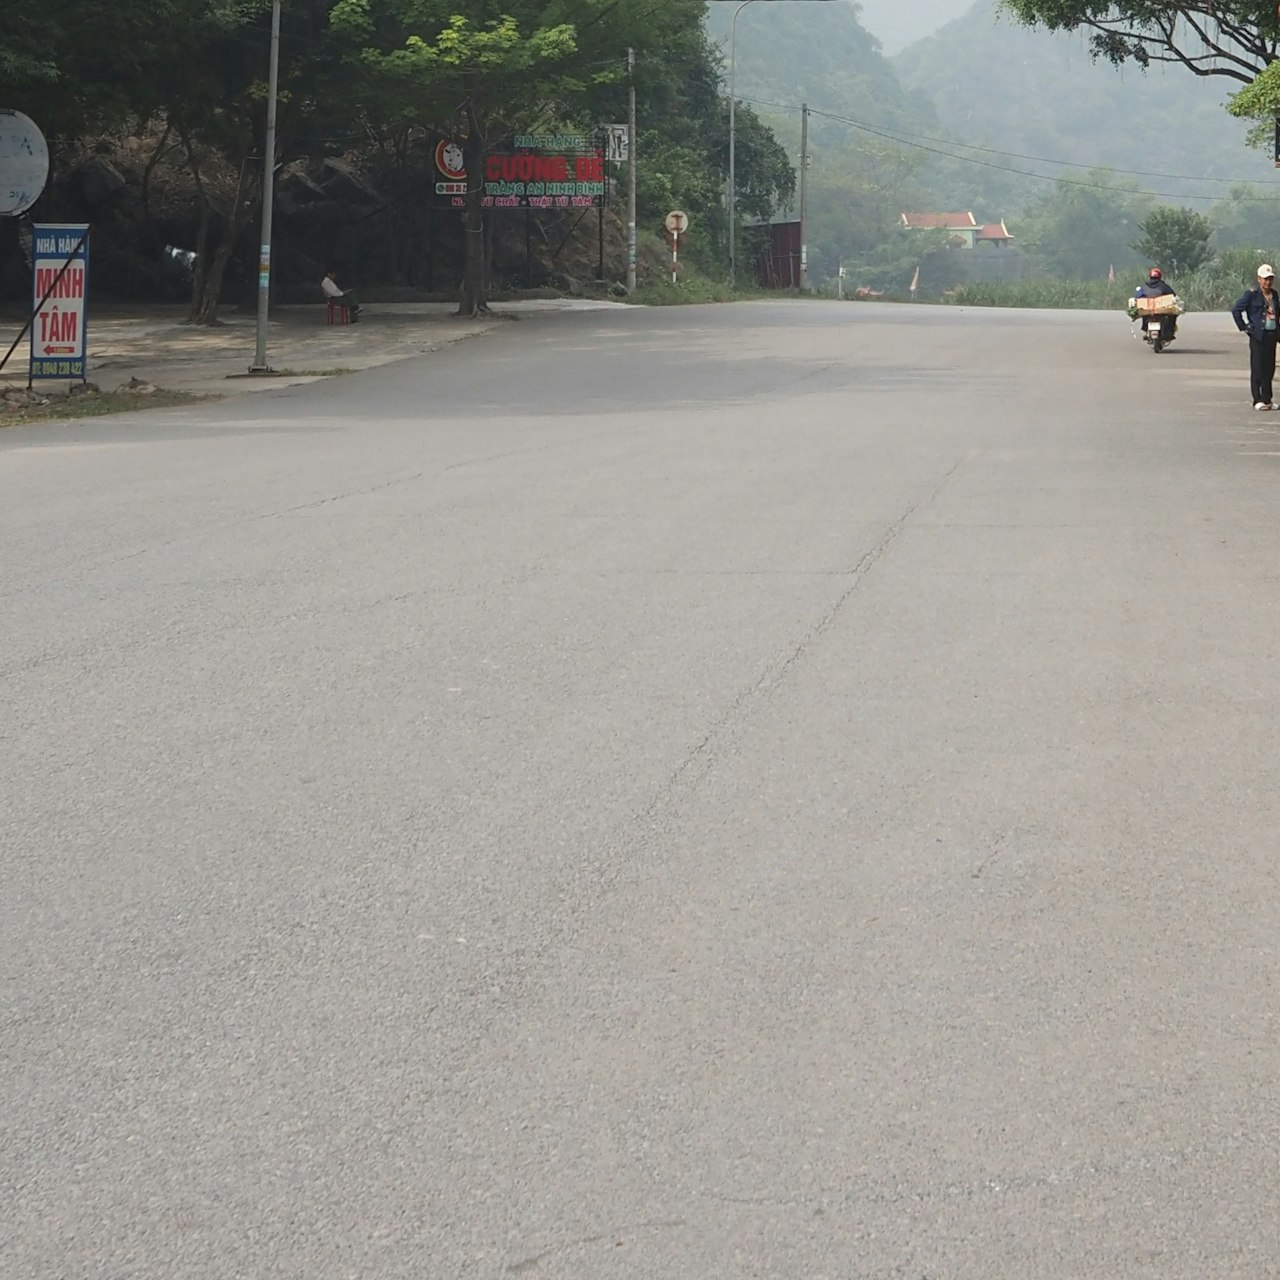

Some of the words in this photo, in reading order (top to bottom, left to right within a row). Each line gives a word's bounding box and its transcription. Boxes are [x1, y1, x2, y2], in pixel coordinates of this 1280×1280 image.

[546, 183, 575, 195] NINH
[36, 235, 56, 253] NHÀ
[36, 268, 84, 299] MINH
[39, 305, 77, 342] TÂM
